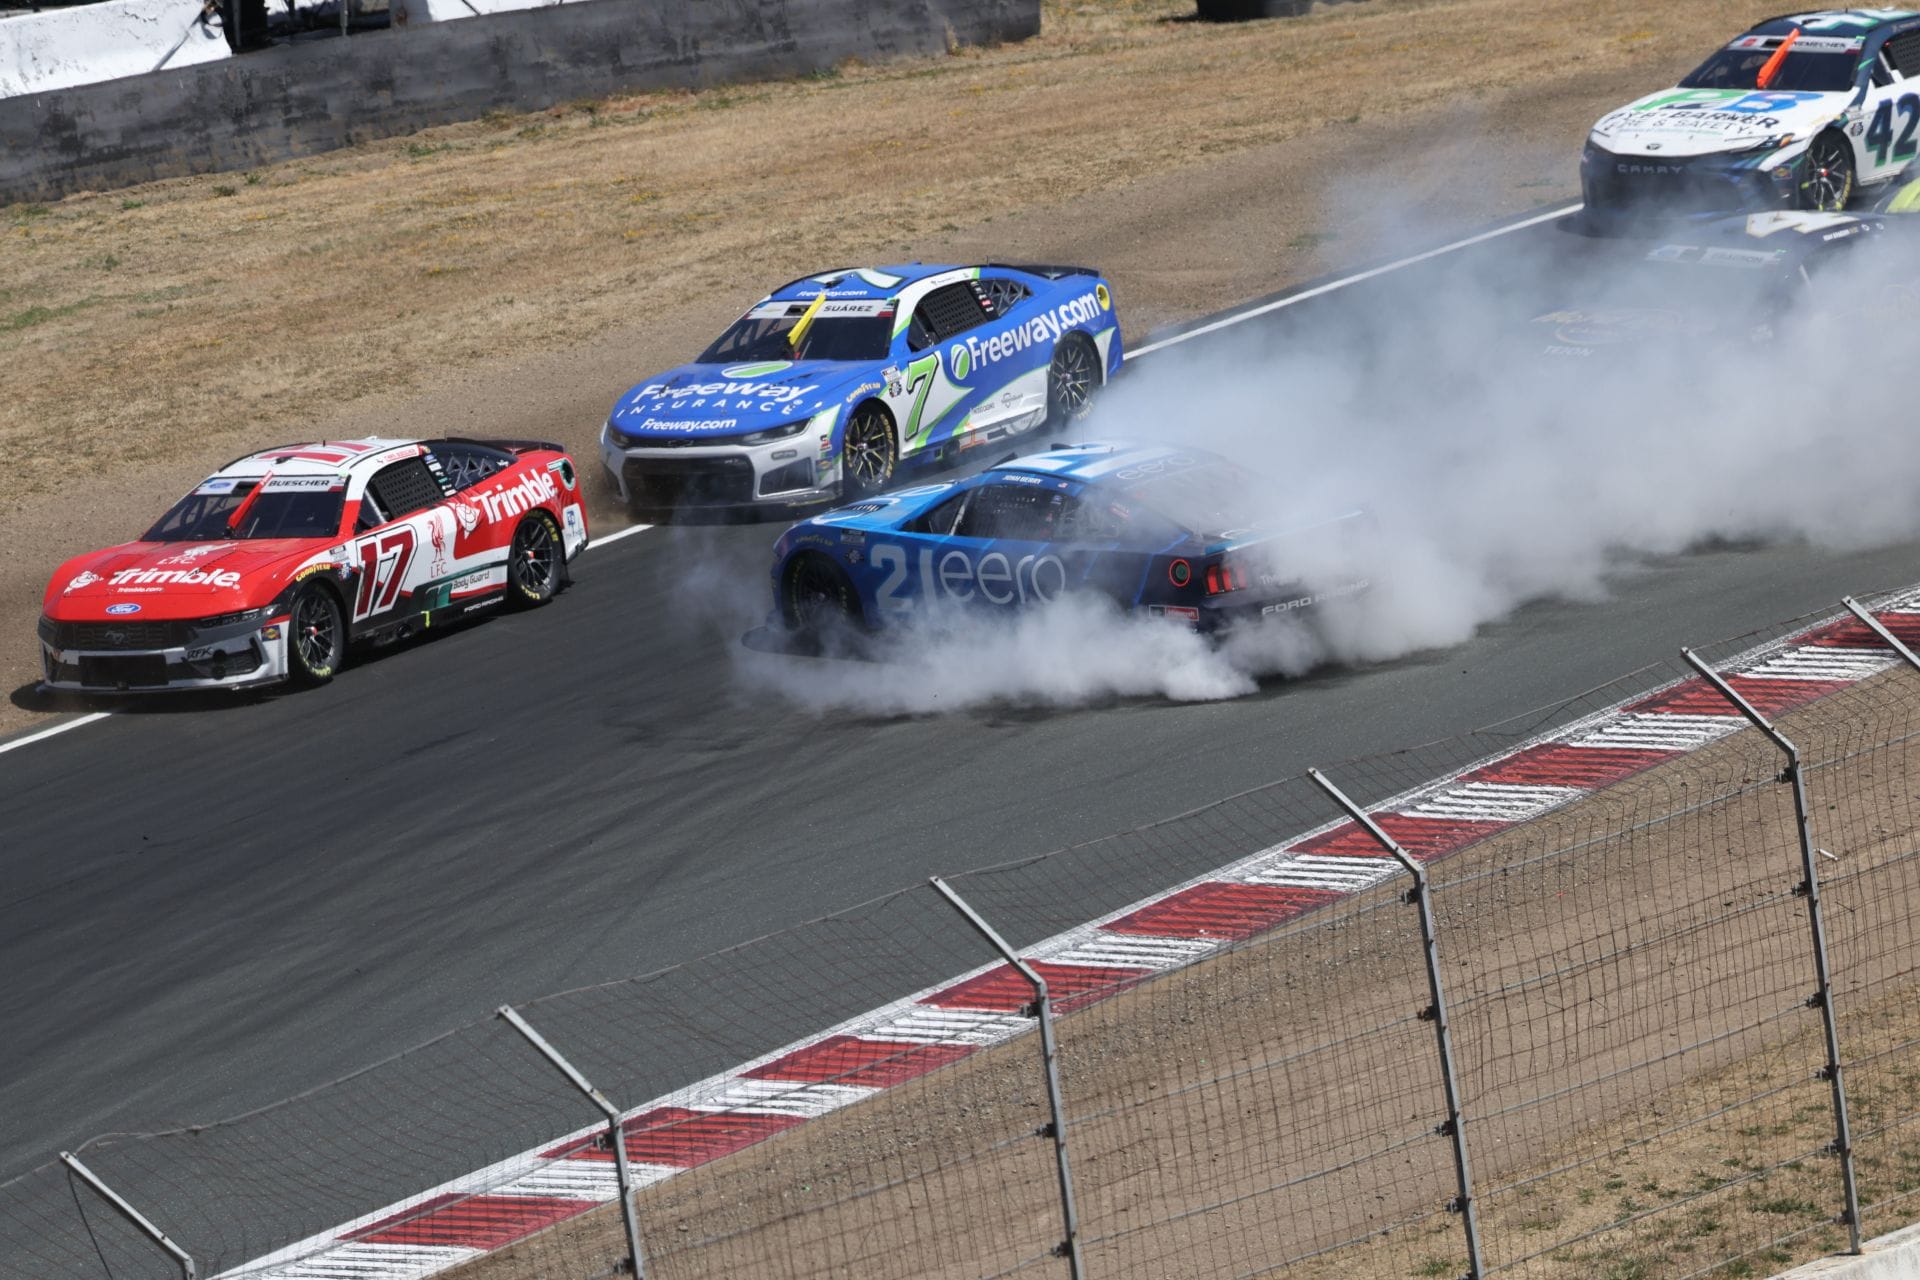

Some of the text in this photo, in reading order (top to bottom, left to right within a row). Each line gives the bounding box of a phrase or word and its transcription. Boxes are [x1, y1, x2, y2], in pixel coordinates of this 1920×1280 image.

[1864, 92, 1920, 168] 42
[1617, 163, 1684, 175] CAMRY
[823, 303, 874, 313] SUÁREZ
[966, 293, 1100, 372] Freeway.com
[631, 381, 820, 403] Freeway
[904, 353, 939, 442] 7
[616, 399, 794, 418] INSURANCE
[640, 418, 738, 432] Freeway.com
[268, 479, 331, 488] BUESCHER
[470, 468, 557, 525] Trimble
[107, 567, 241, 588] Trimble
[295, 562, 331, 582] GOODYEAR
[353, 526, 415, 623] 17
[430, 561, 448, 579] LFC
[939, 551, 1066, 605] eero
[1262, 597, 1312, 616] FORD
